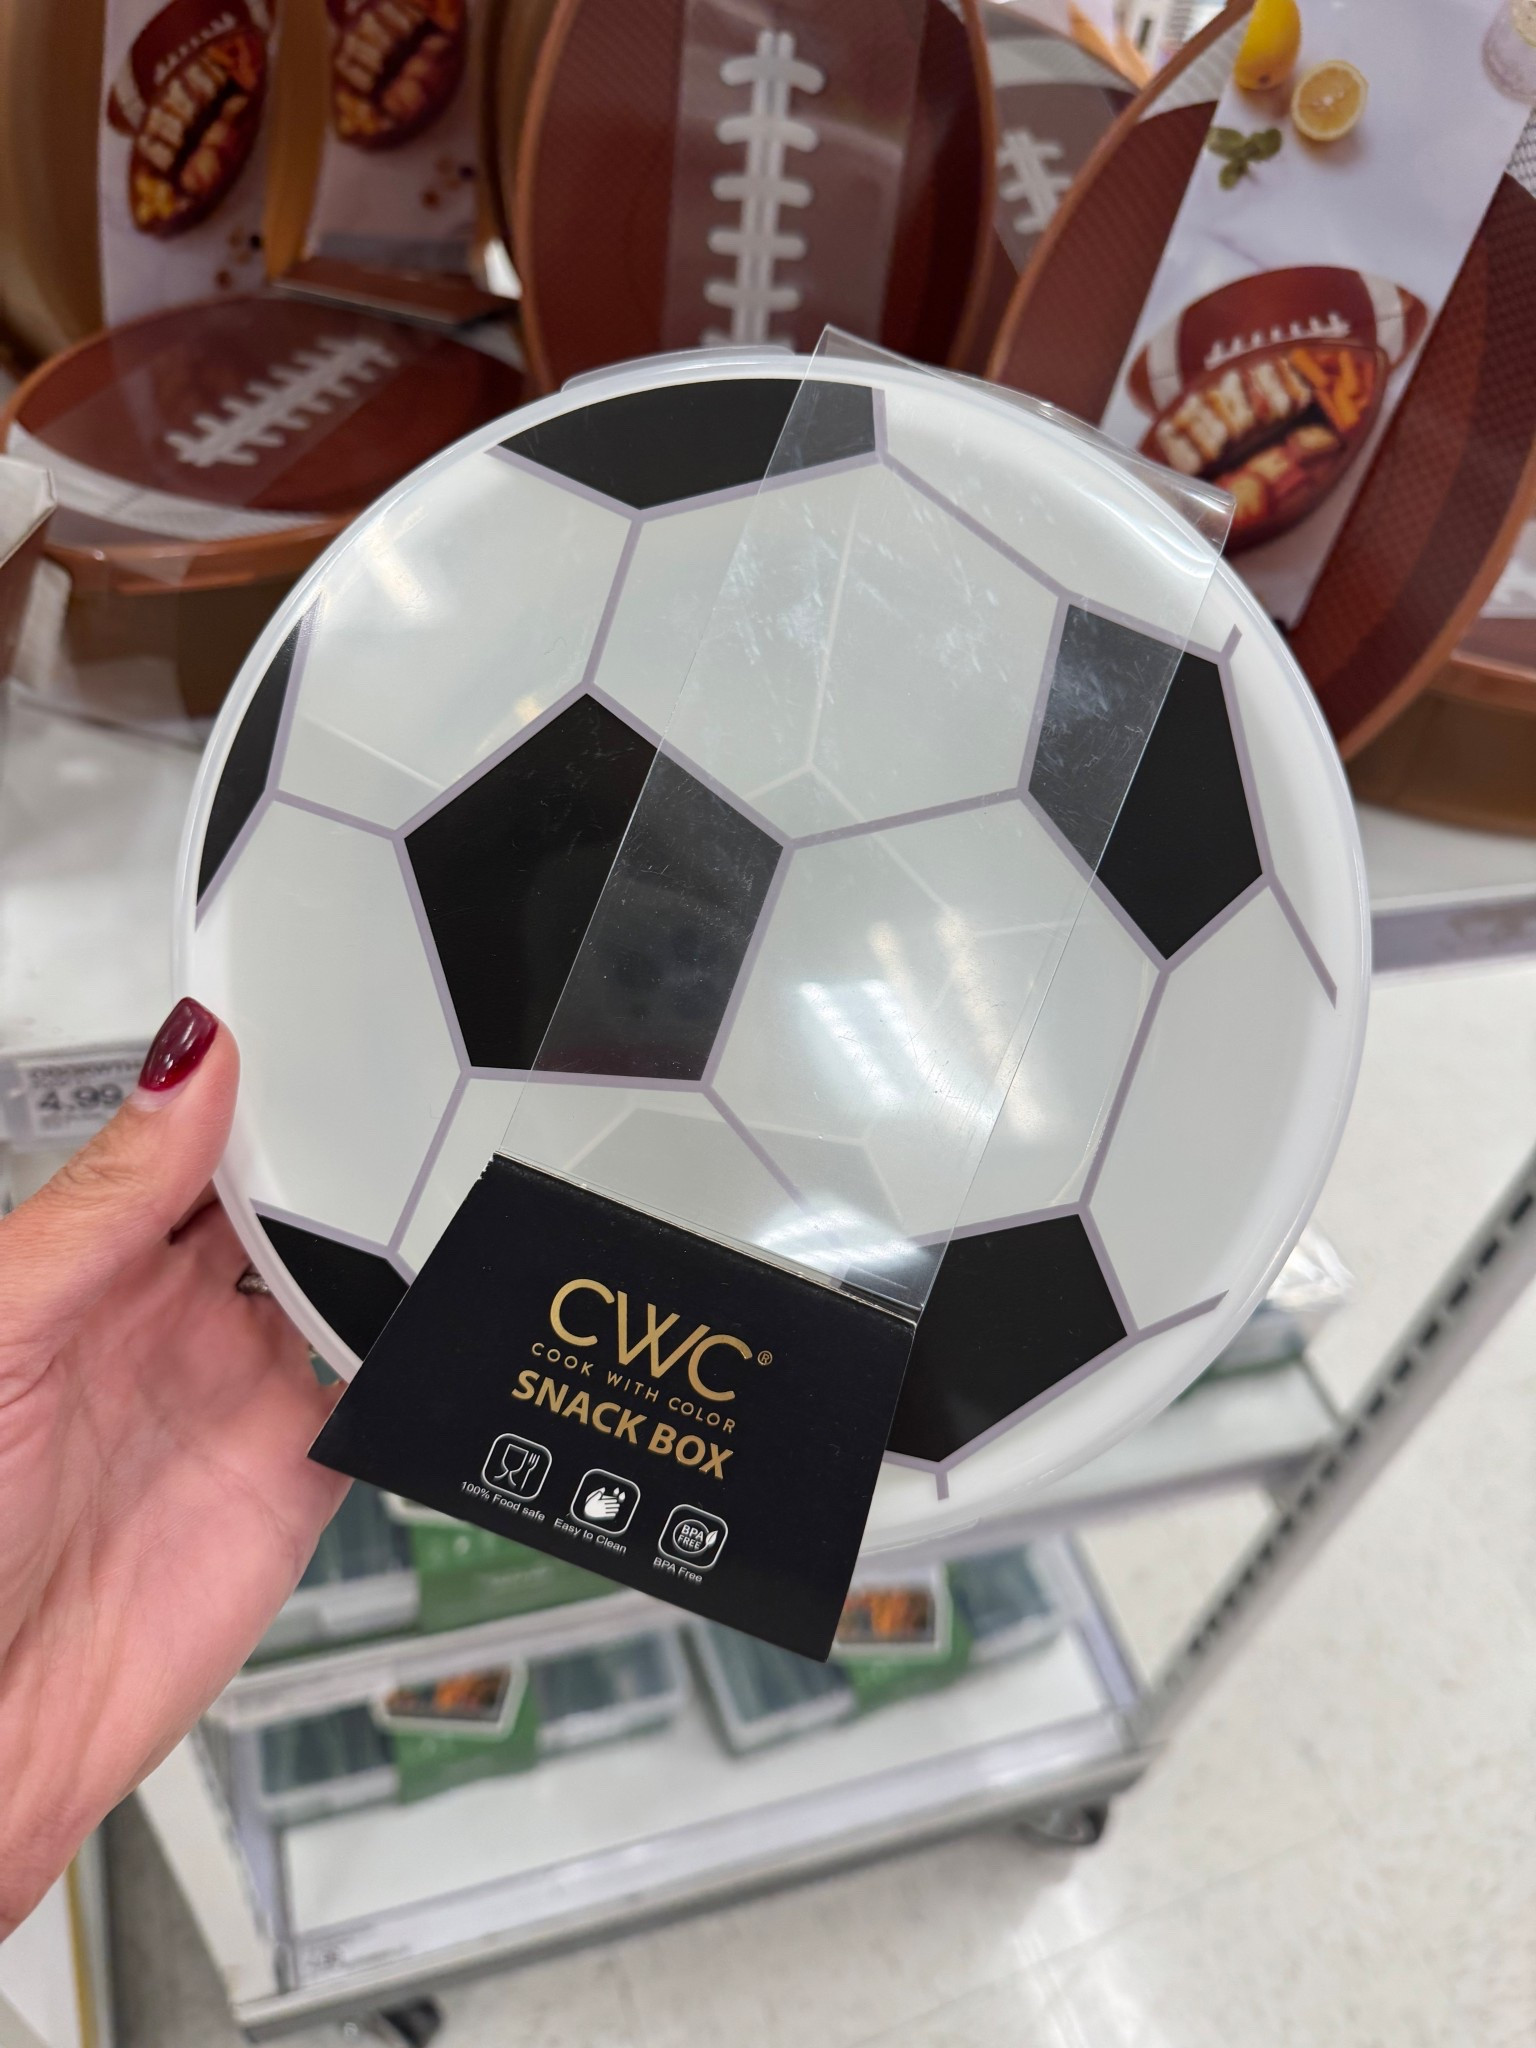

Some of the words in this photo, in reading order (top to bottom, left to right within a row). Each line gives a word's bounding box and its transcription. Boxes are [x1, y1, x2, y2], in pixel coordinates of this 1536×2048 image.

[39, 1084, 122, 1110] 4.99
[531, 1342, 594, 1376] COOK
[607, 1370, 660, 1402] WITH
[668, 1397, 736, 1433] COLOR
[511, 1369, 648, 1444] SNACK
[648, 1422, 734, 1480] BOX
[461, 1480, 490, 1499] 100%
[493, 1494, 521, 1512] Food
[522, 1508, 546, 1522] safe
[554, 1517, 581, 1537] Easy
[583, 1531, 594, 1541] to
[596, 1535, 627, 1553] Clean
[677, 1534, 702, 1549] FREE
[681, 1524, 704, 1542] BPA
[653, 1556, 676, 1573] BPA
[678, 1567, 703, 1582] Free
